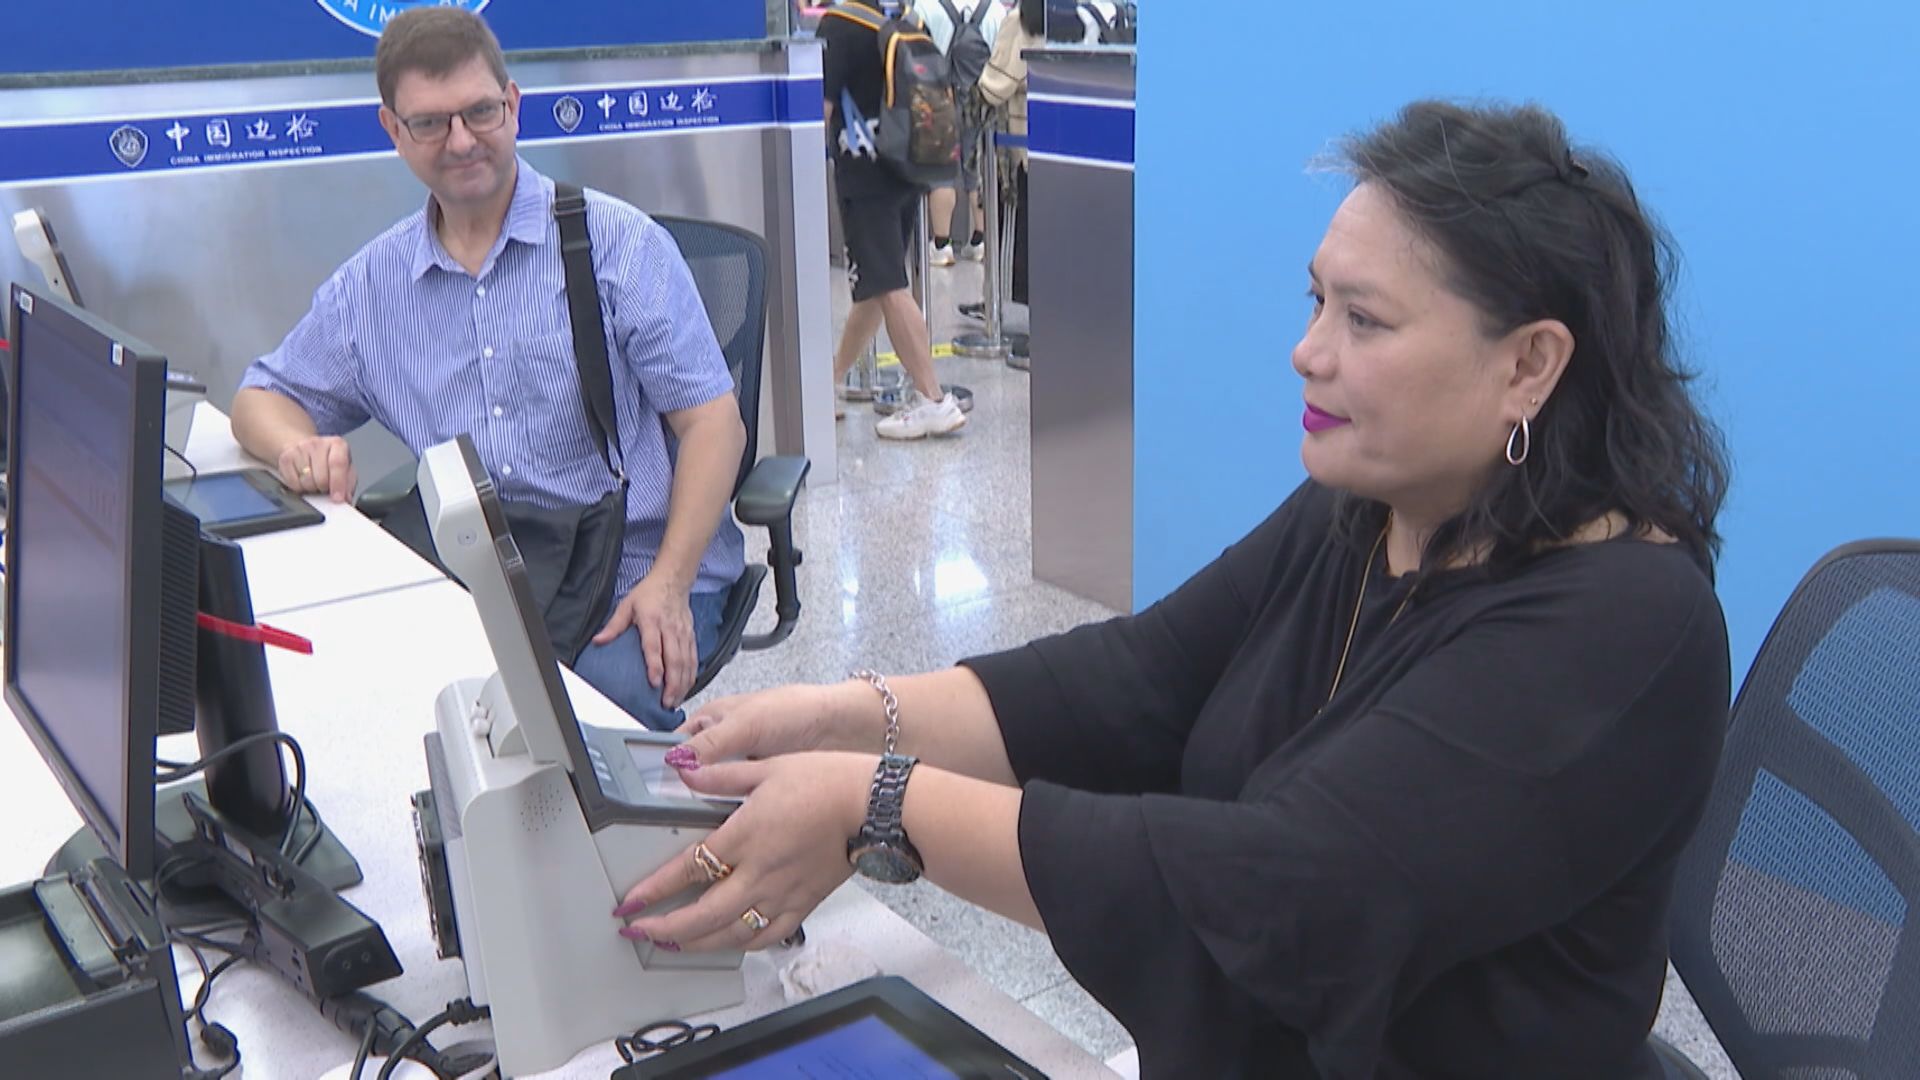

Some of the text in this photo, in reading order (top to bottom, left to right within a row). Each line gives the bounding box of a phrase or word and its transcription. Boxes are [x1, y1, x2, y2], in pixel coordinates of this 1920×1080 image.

[597, 87, 718, 119] 中国边检
[165, 113, 320, 152] 中国边检
[170, 145, 323, 166] CHINA IMMIGRATION INSPECTION
